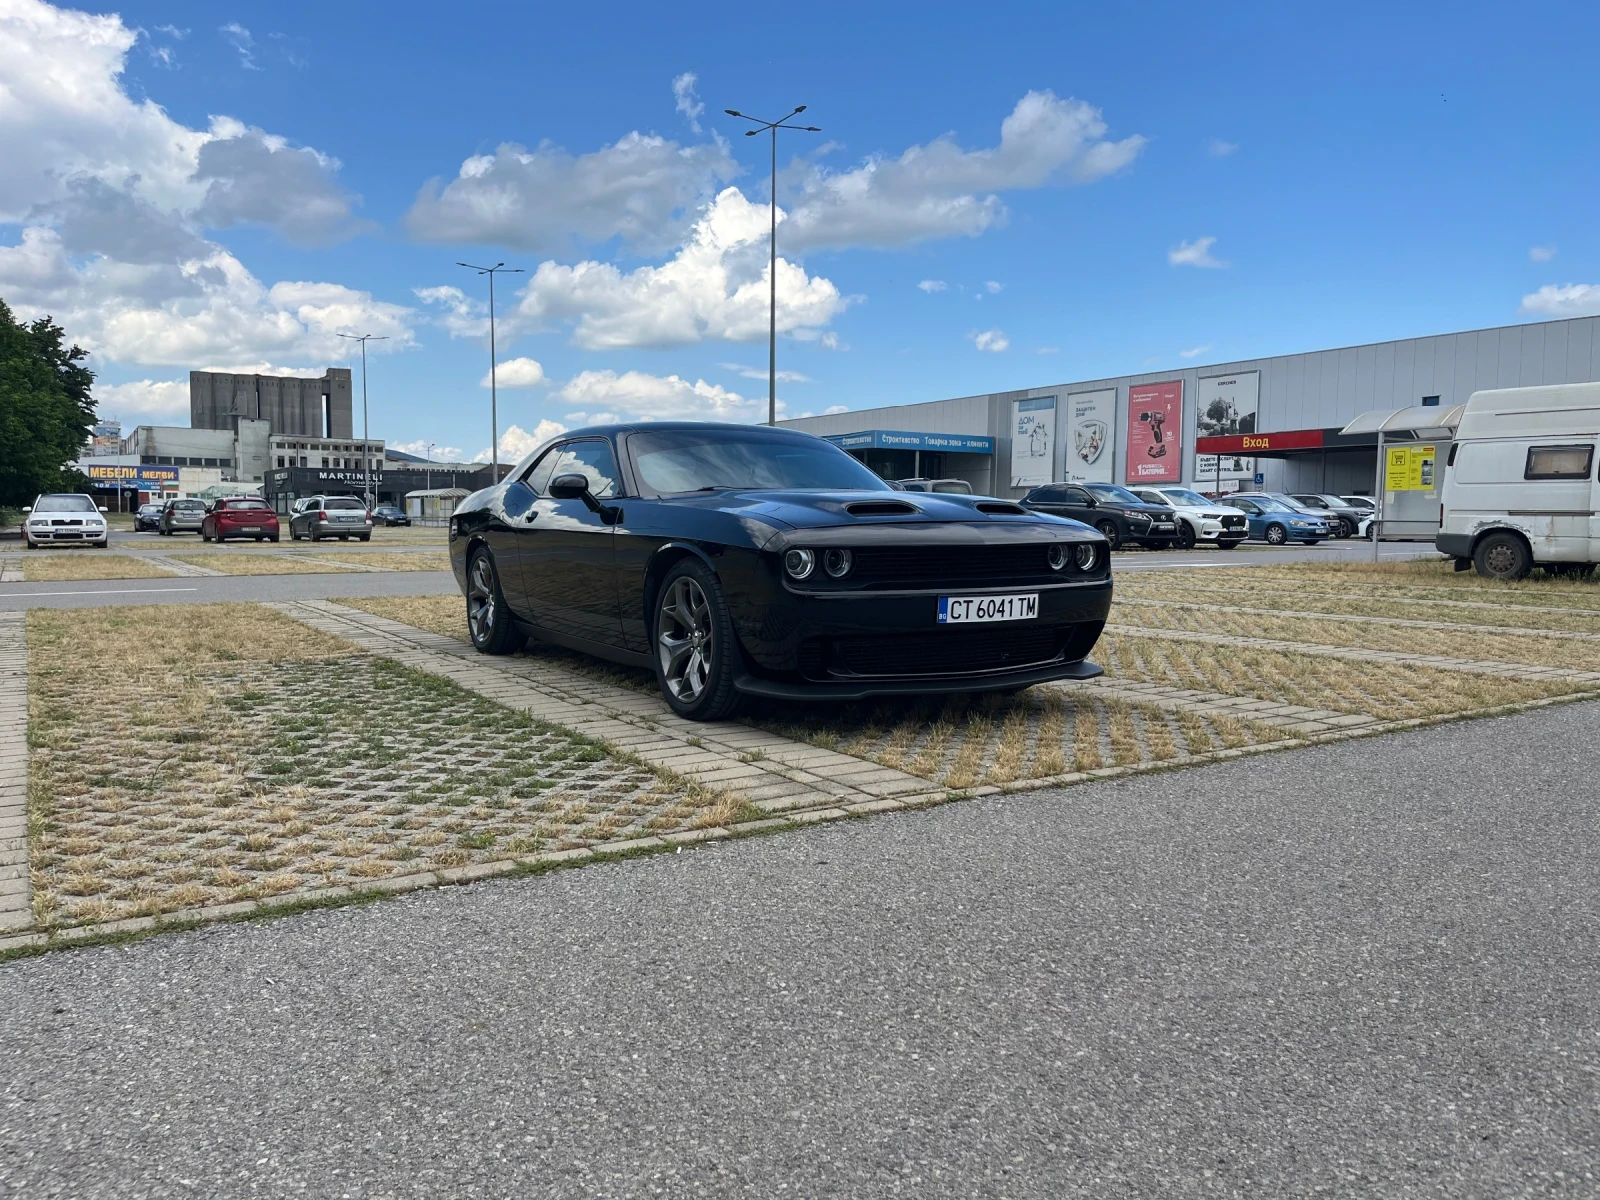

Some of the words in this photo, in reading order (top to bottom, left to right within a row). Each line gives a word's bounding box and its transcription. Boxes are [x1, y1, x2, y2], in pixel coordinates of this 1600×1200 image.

[1018, 416, 1035, 425] ДОМ
[842, 436, 872, 445] Строителство
[881, 434, 920, 444] Строителство
[925, 436, 947, 447] Товарна
[967, 440, 989, 448] клиенти
[1243, 437, 1269, 448] Вход
[90, 467, 137, 479] МЕБЕЛИ
[950, 600, 974, 620] CT
[976, 598, 1014, 619] 6041
[1018, 596, 1036, 617] TM
